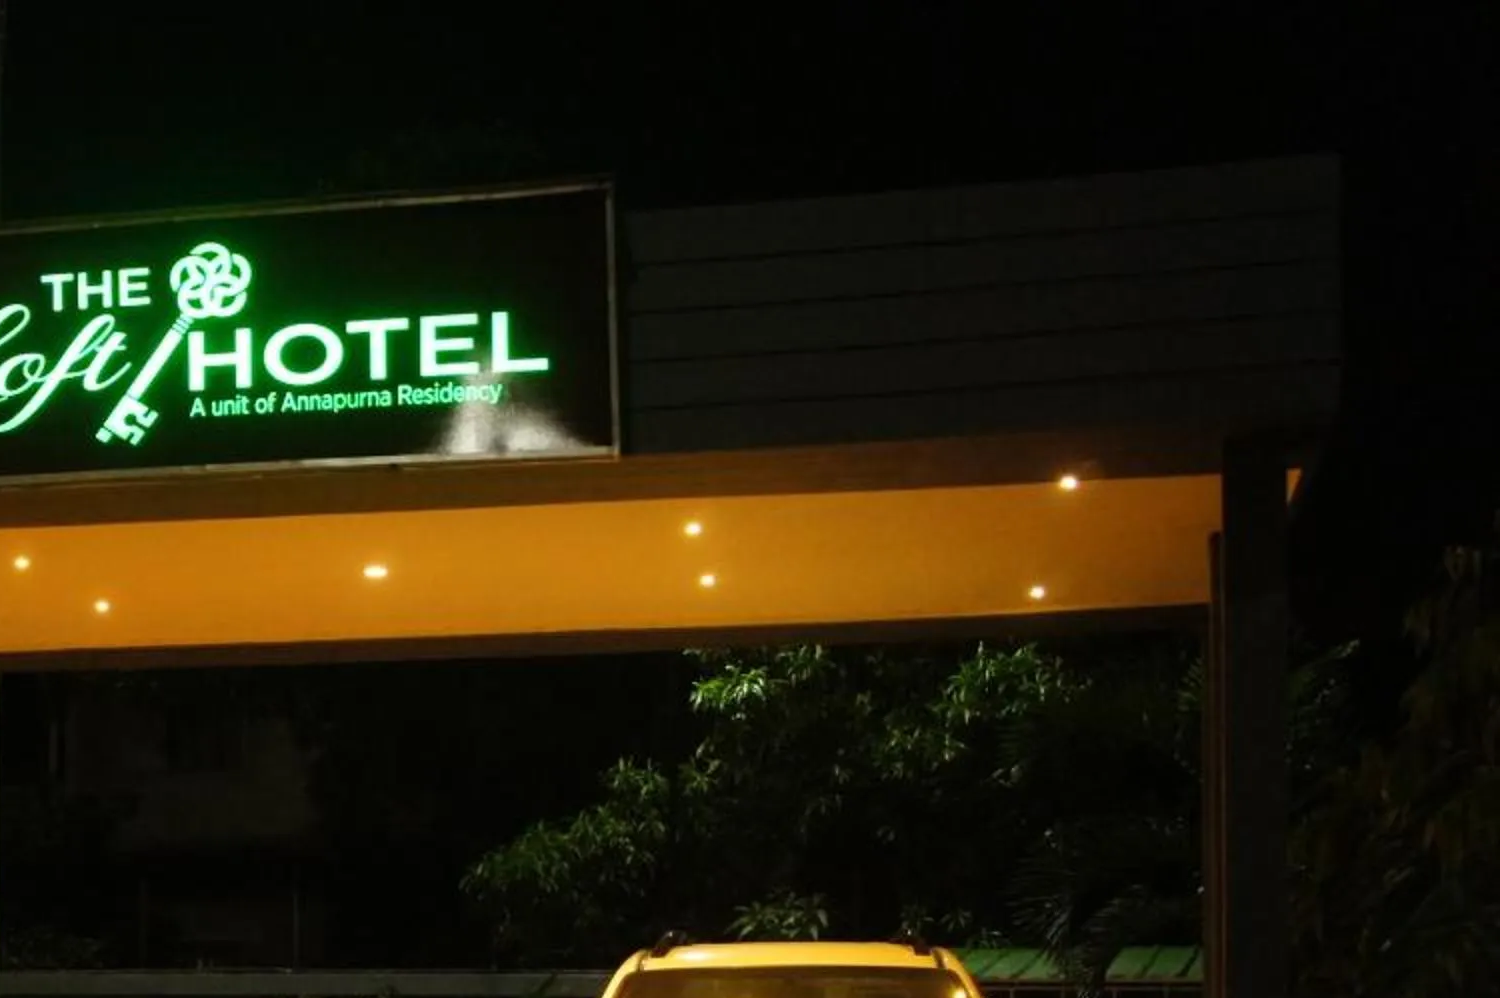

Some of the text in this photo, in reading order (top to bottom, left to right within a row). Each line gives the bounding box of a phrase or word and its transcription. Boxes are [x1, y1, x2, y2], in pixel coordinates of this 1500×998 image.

[40, 267, 152, 312] THE
[187, 311, 550, 392] HOTEL
[189, 381, 503, 418] A unit of Annapurna Residency
